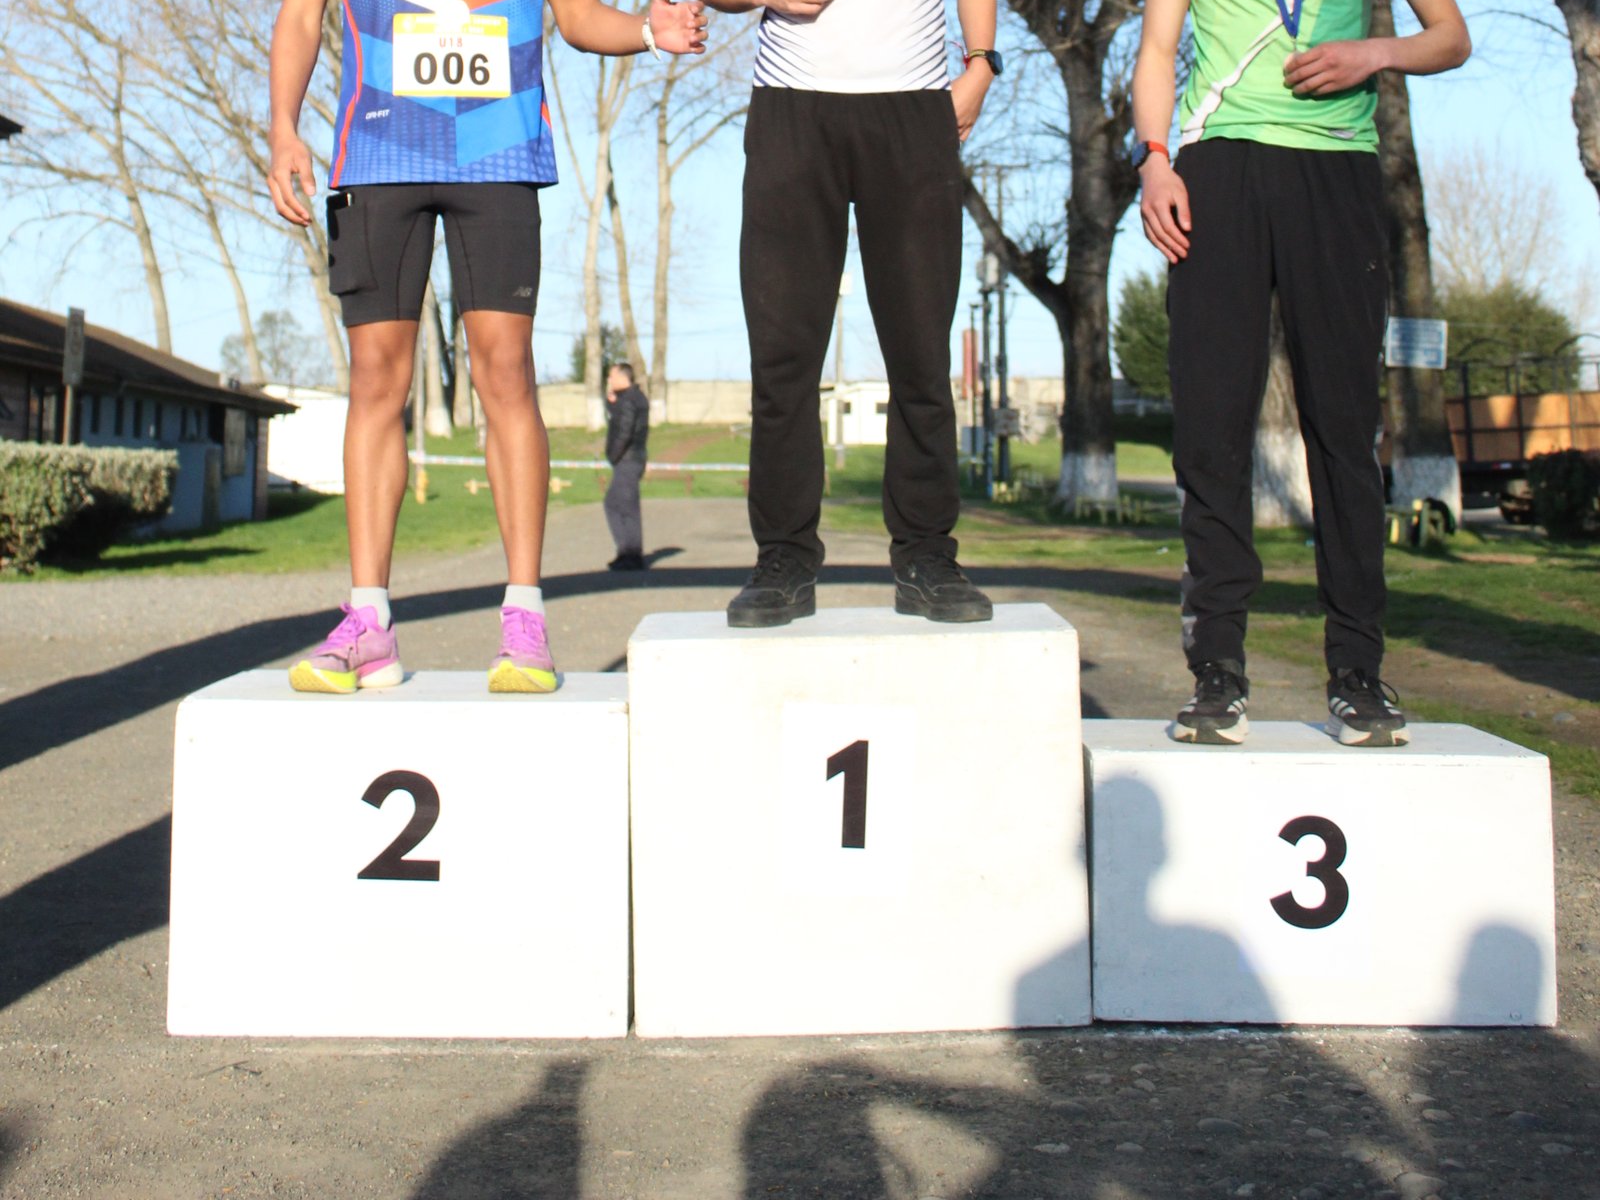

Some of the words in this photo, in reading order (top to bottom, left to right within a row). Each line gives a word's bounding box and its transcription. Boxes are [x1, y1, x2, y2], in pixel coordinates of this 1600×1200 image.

[413, 52, 490, 86] 006
[439, 37, 463, 48] U18
[356, 769, 441, 882] 2
[825, 739, 869, 850] 1
[1269, 814, 1350, 930] 3
